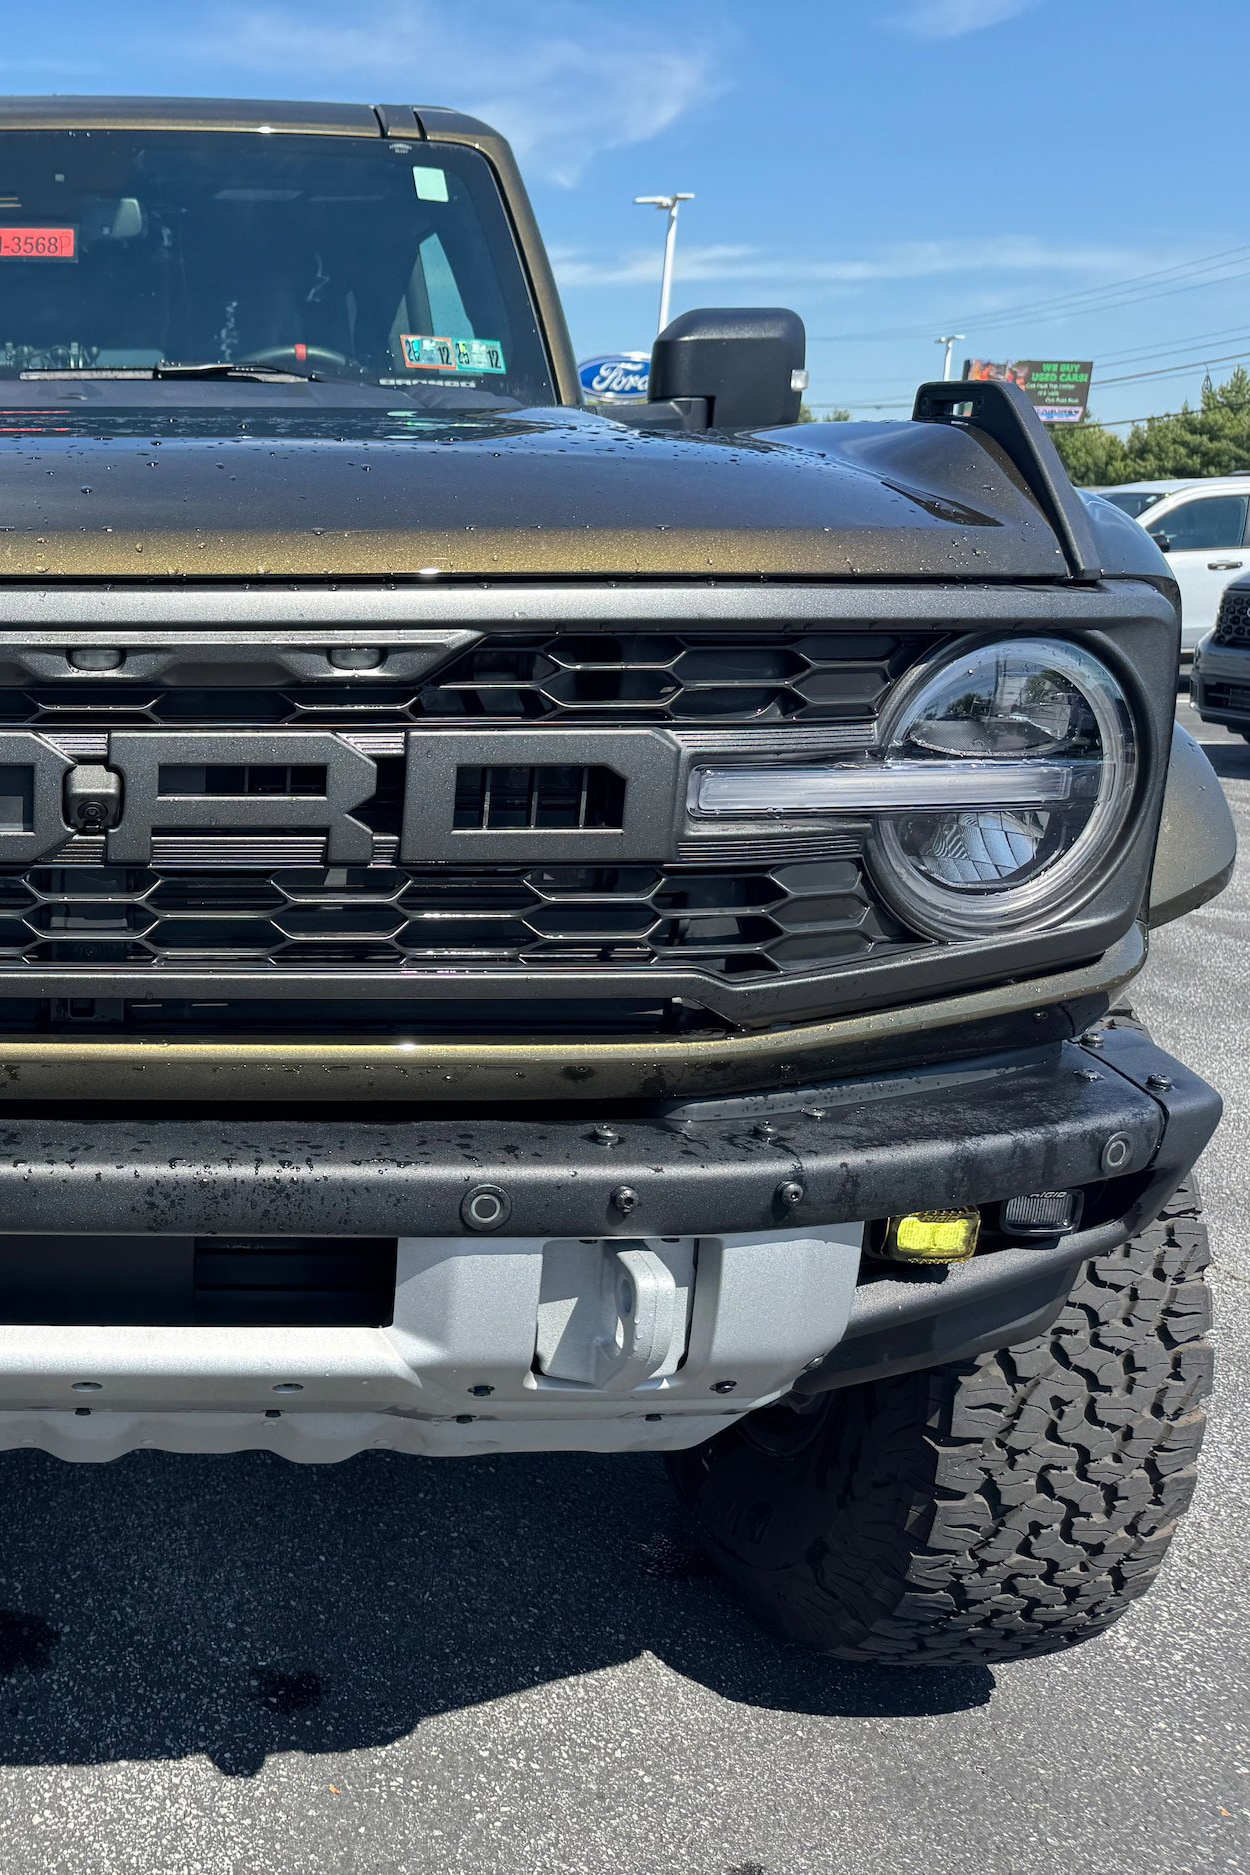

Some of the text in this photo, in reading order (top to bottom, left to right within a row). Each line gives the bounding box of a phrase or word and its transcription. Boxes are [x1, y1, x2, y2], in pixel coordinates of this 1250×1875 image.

[437, 346, 453, 365] 12
[486, 350, 502, 369] 12
[1042, 363, 1059, 372] WE
[1031, 372, 1058, 382] USED
